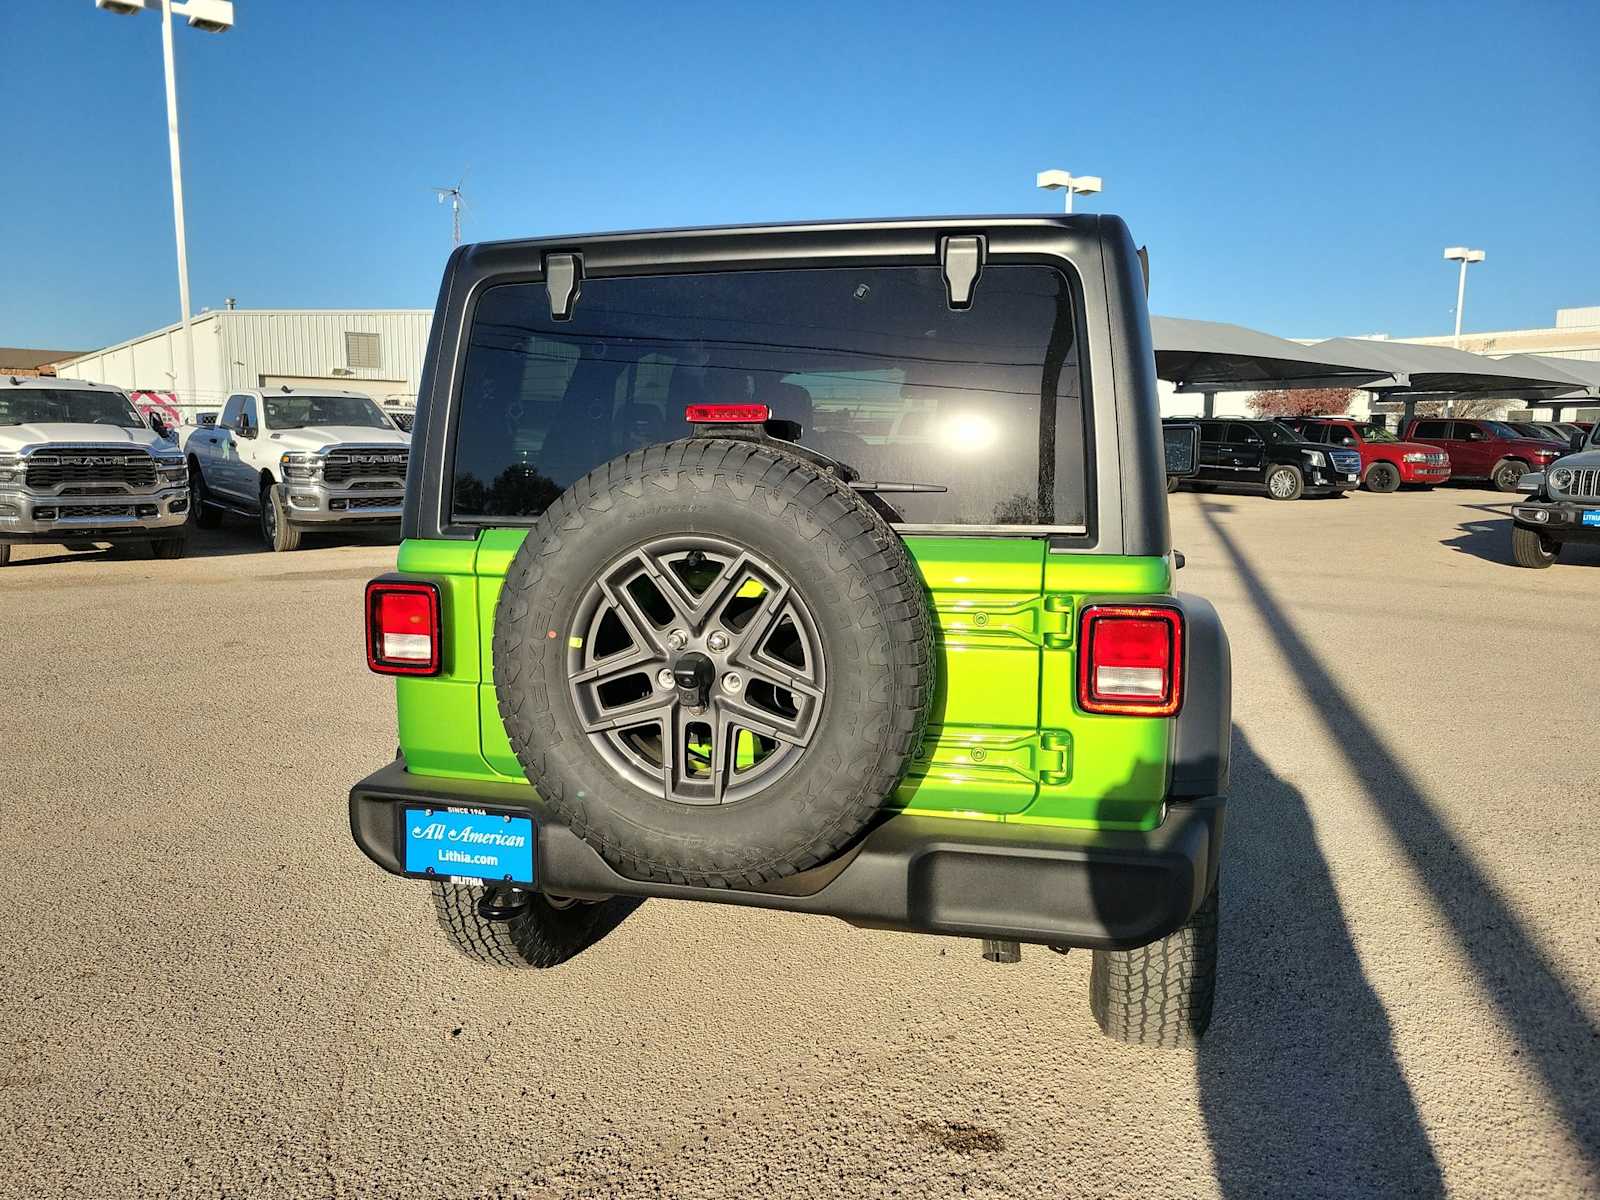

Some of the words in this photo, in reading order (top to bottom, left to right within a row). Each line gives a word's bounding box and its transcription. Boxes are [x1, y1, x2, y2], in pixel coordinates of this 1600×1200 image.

[447, 807, 469, 815] SINCE
[412, 823, 446, 841] All
[447, 826, 525, 848] American
[438, 849, 498, 866] Lithia.com
